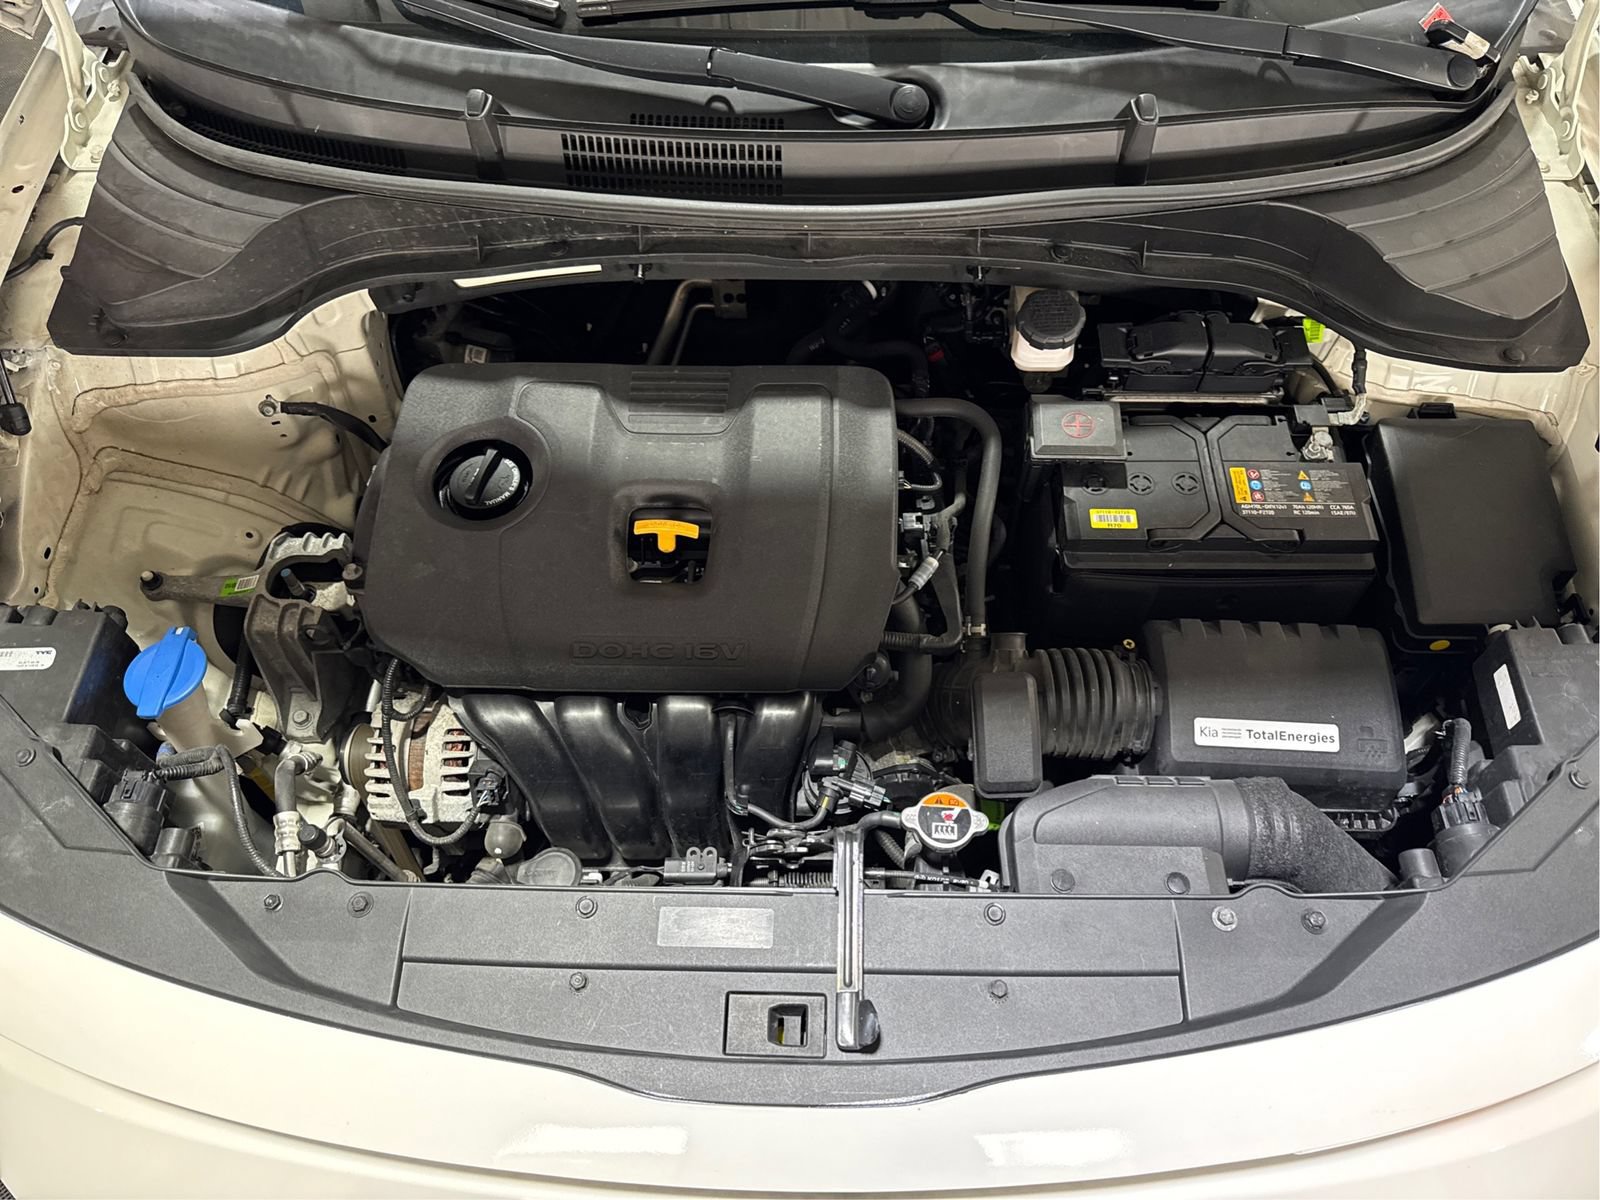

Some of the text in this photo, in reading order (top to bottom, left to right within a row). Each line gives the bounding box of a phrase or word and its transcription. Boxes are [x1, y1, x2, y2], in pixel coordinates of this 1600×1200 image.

[484, 491, 511, 506] MANUAL
[572, 641, 745, 660] DOHC 16V
[1199, 726, 1335, 745] Kia TotalEnergies
